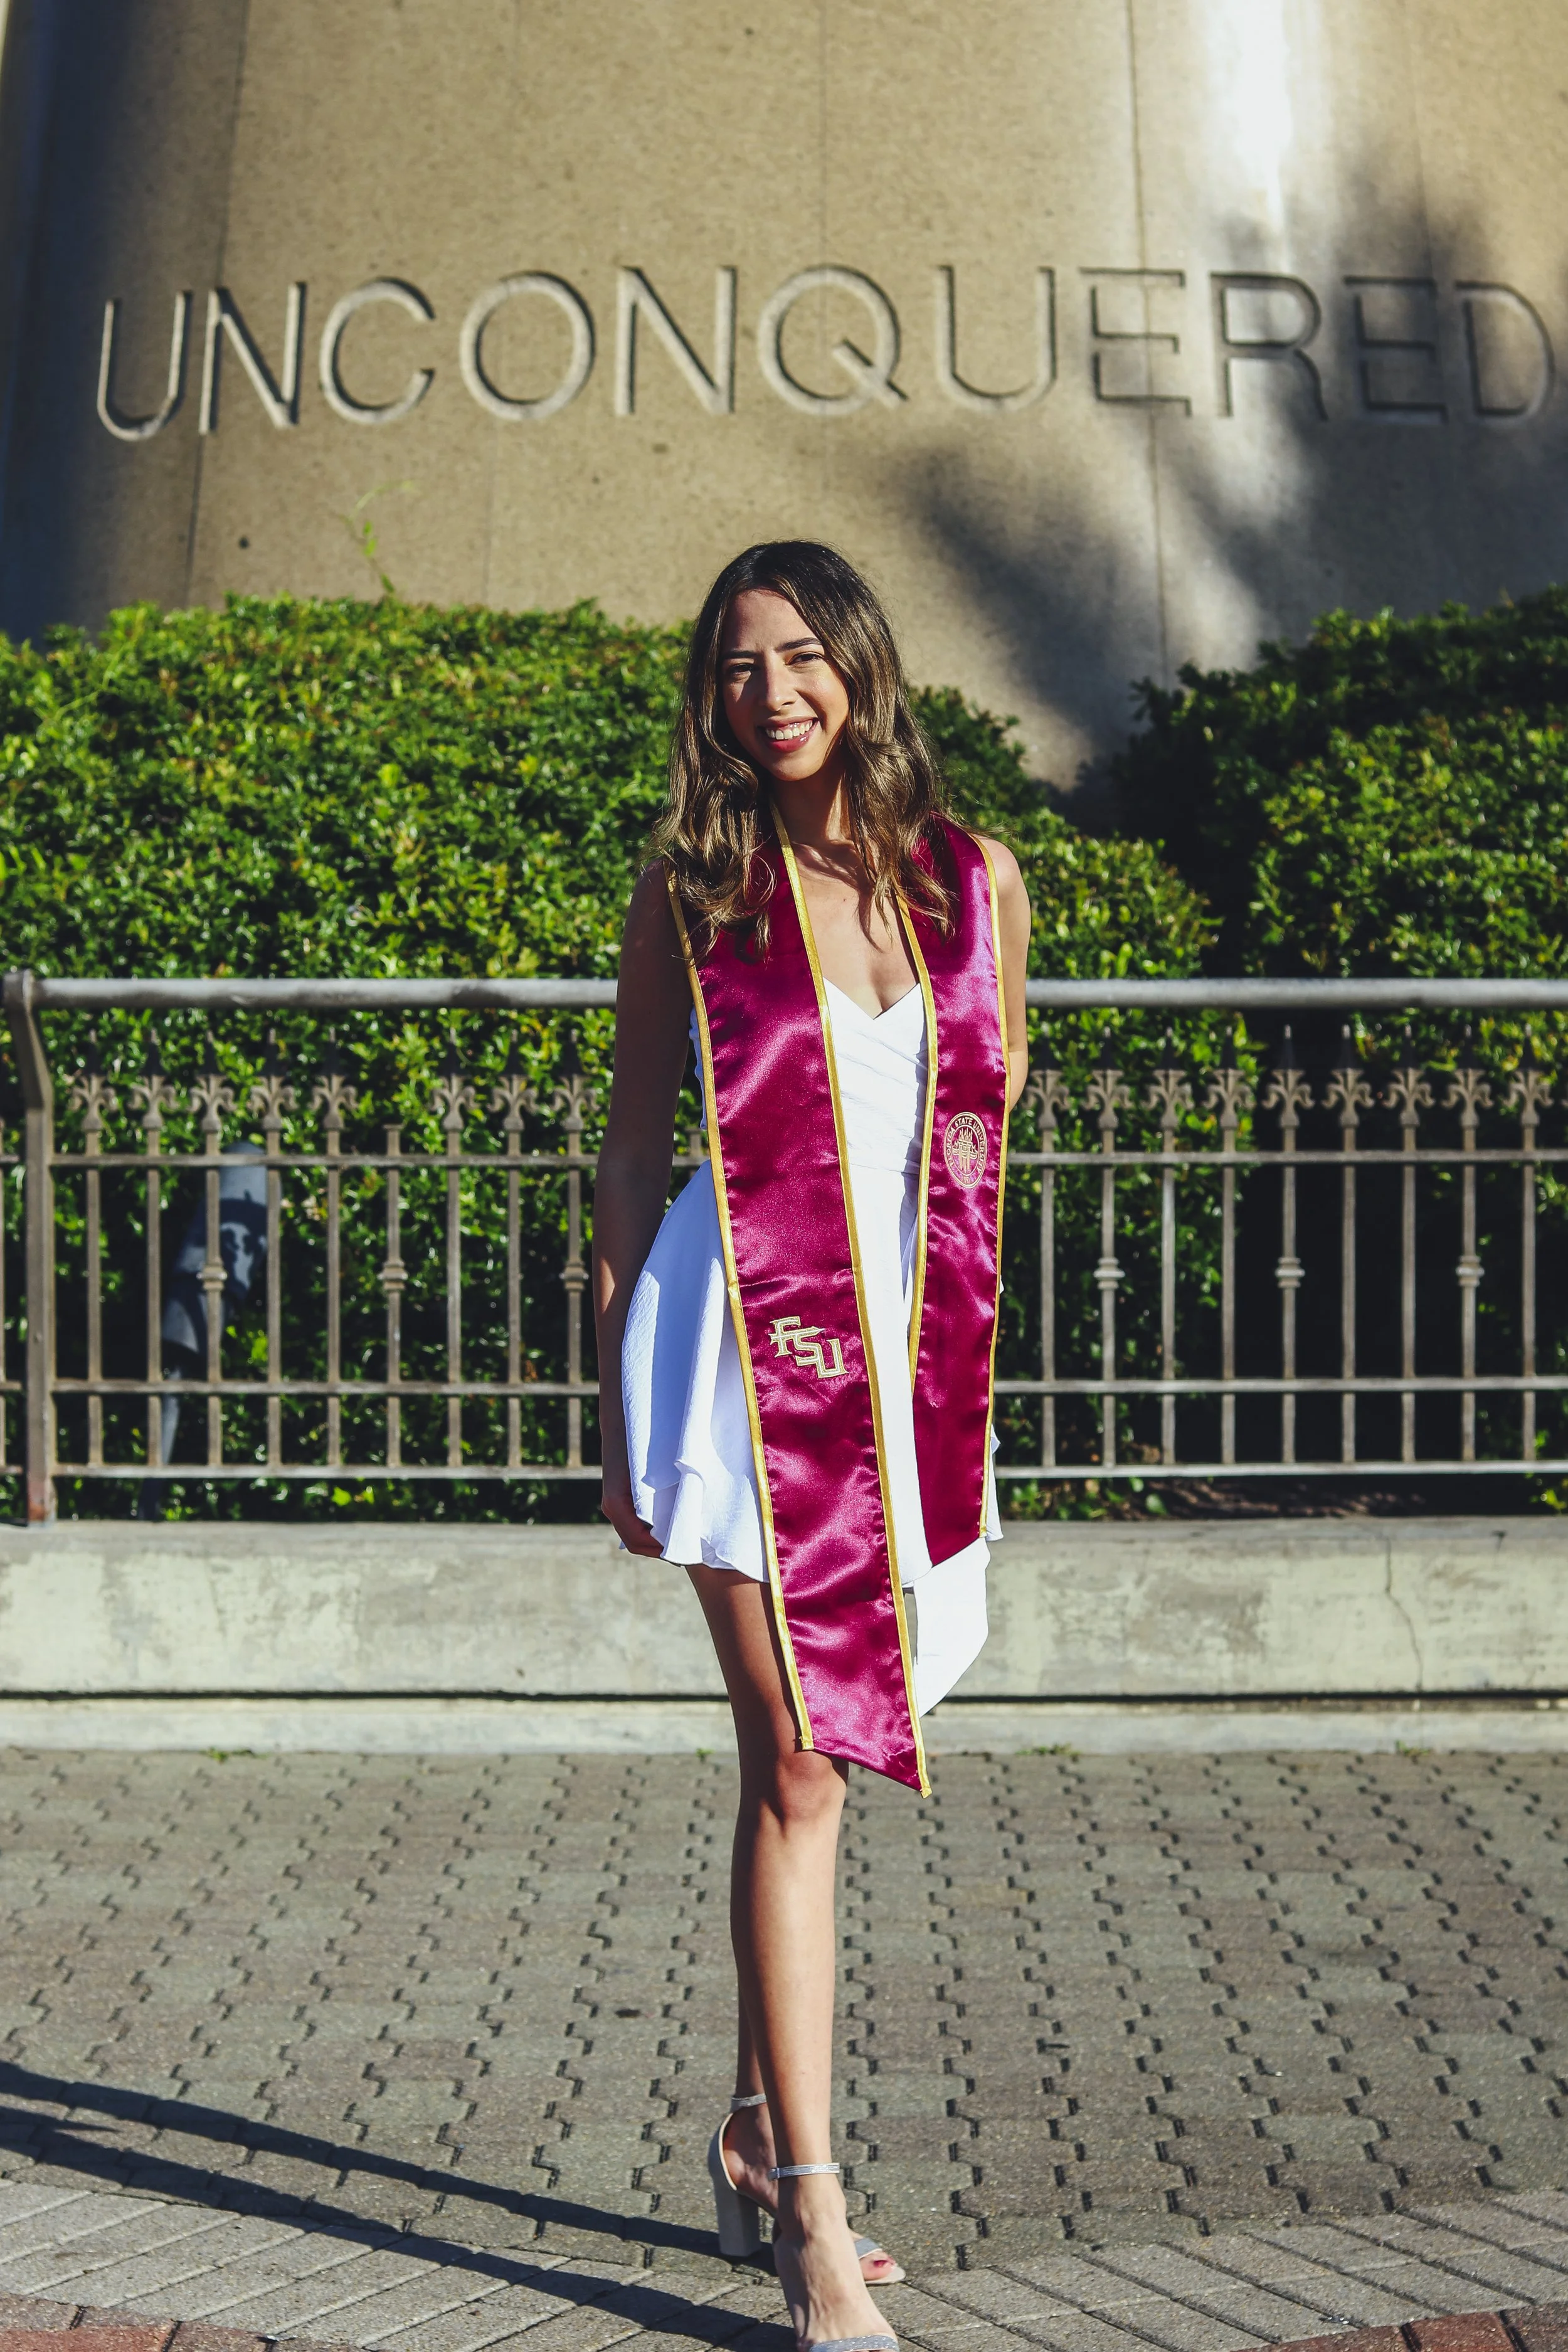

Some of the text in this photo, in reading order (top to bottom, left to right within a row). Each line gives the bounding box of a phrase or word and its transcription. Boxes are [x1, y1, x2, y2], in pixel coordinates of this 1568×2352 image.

[97, 265, 1554, 441] UNCONQUERED
[955, 1117, 973, 1126] STATE
[973, 1120, 985, 1173] UNIVERSITY
[768, 1316, 850, 1379] FSU
